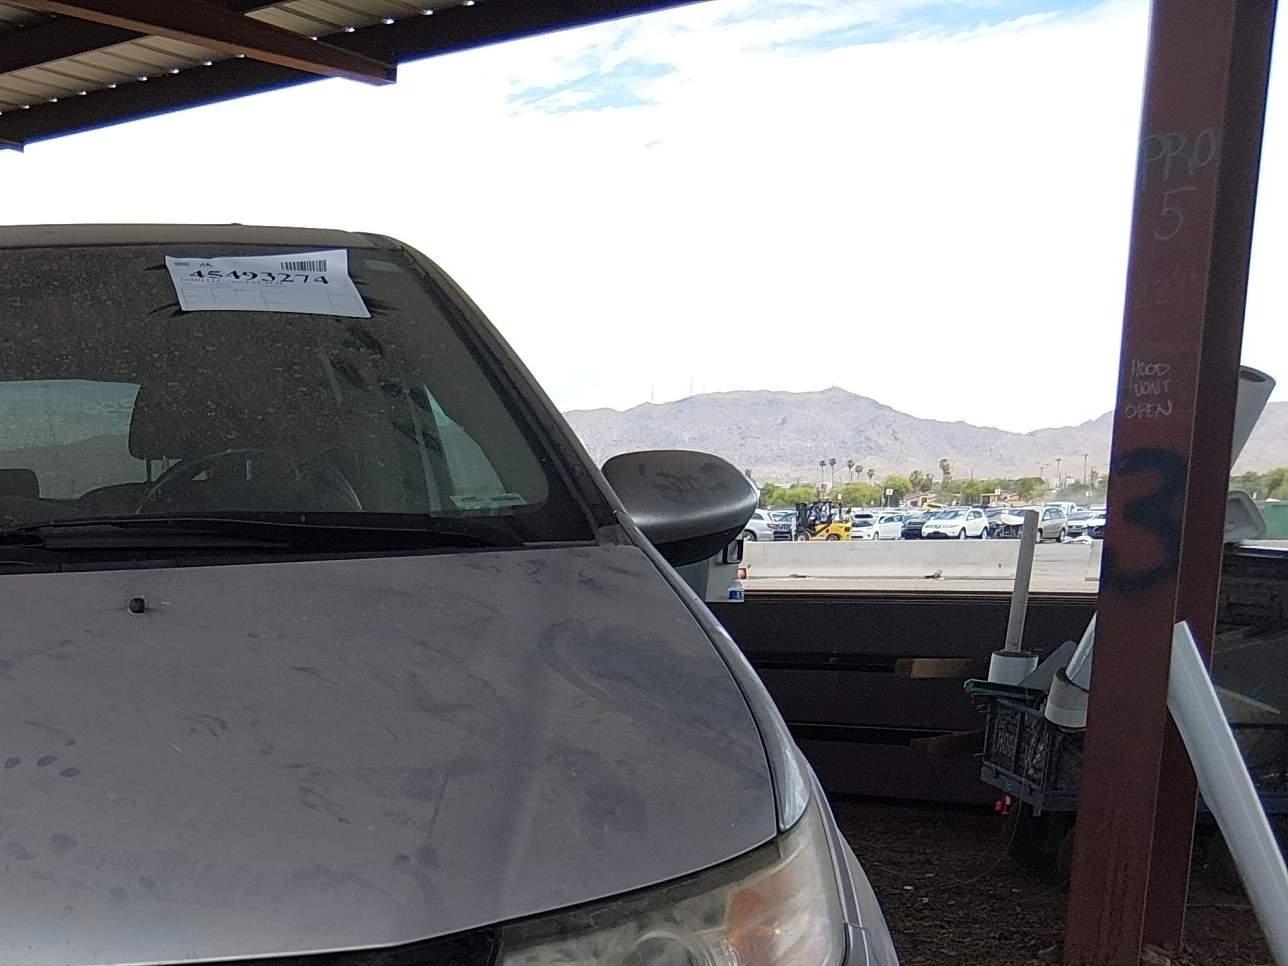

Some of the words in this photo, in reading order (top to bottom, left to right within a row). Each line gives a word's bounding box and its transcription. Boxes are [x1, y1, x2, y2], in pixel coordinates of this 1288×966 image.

[1154, 187, 1198, 240] 5
[189, 269, 330, 285] 45493274
[1103, 448, 1189, 594] 3
